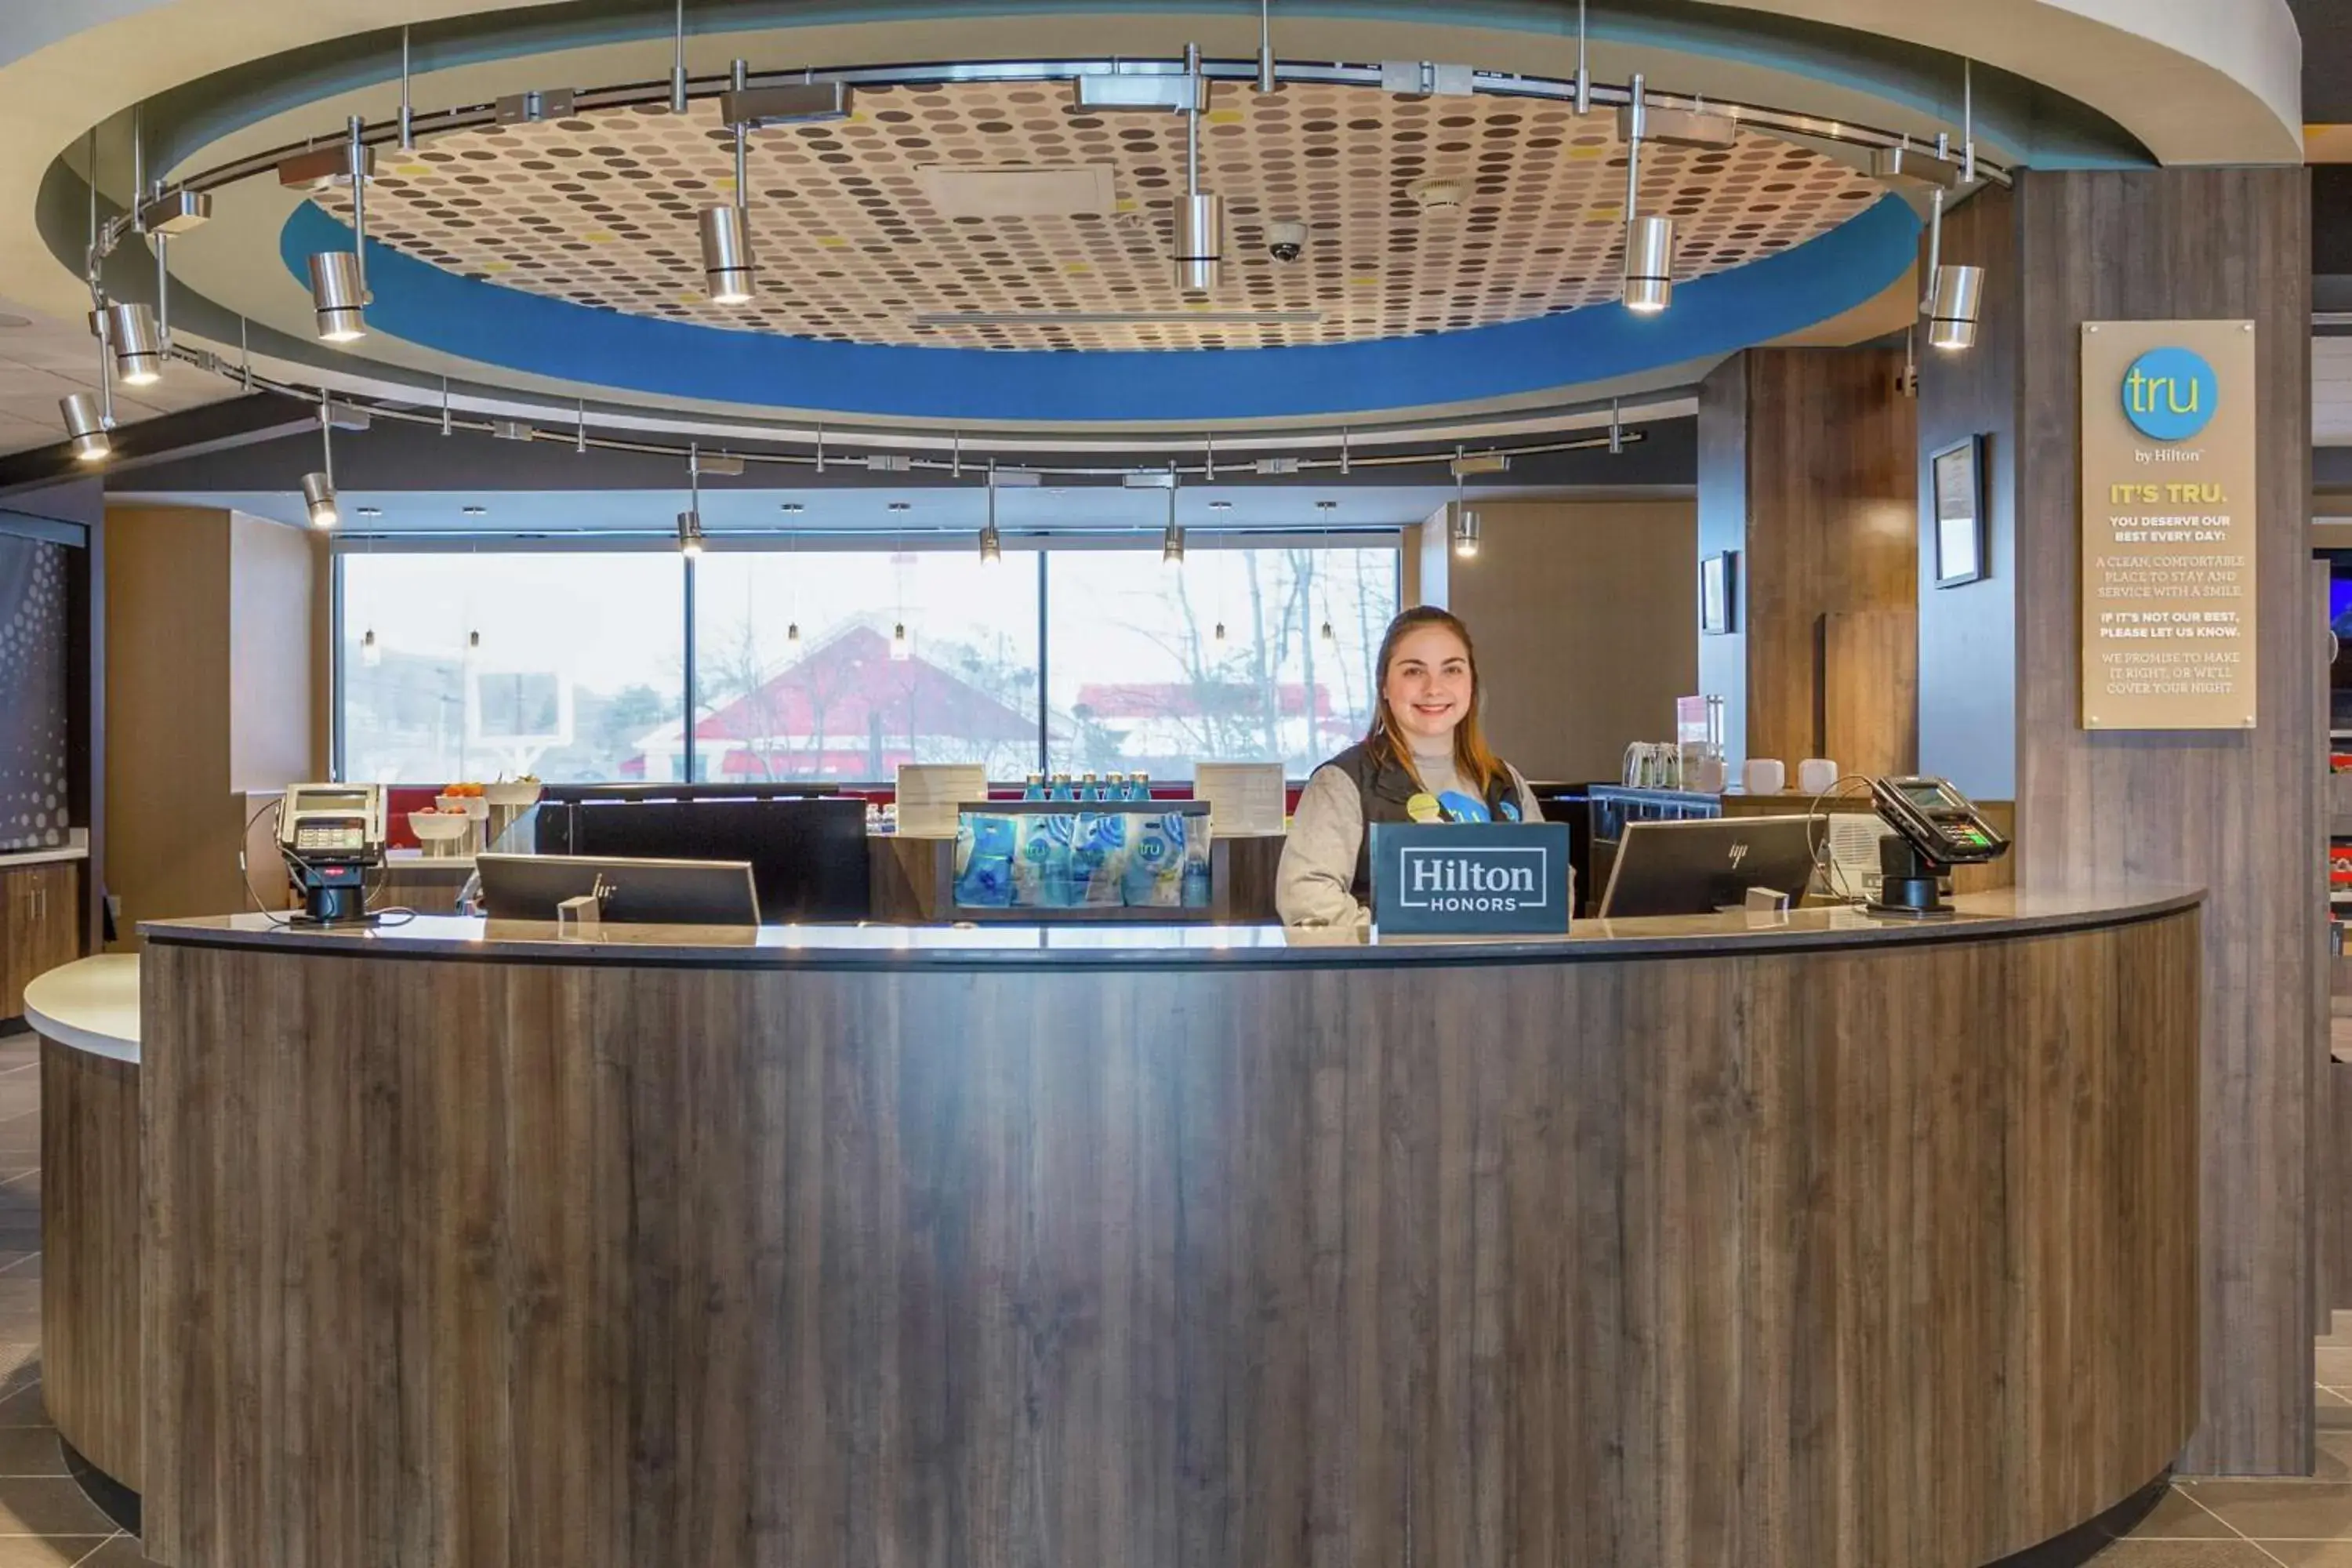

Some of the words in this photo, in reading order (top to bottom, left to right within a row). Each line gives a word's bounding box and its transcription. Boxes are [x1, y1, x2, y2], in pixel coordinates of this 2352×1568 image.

[2127, 368, 2198, 414] tru
[2135, 449, 2152, 464] by
[2111, 484, 2159, 504] IT'S
[2165, 483, 2228, 504] TRU.
[2110, 516, 2138, 528] YOU
[2141, 516, 2199, 527] DESERVE
[2201, 515, 2230, 527] OUR
[2115, 531, 2147, 543] BEST
[2151, 531, 2192, 543] EVERY
[2194, 530, 2227, 542] DAY:
[2096, 557, 2105, 568] A
[2107, 557, 2151, 568] CLEAN,
[2154, 555, 2245, 568] COMFORTABLE
[2104, 572, 2147, 583] PLACE
[2149, 572, 2169, 583] TO
[2171, 571, 2205, 583] STAY
[2207, 571, 2238, 584] AND
[2097, 587, 2151, 598] SERVICE
[2153, 586, 2189, 598] WITH
[2190, 586, 2201, 598] A
[2100, 612, 2114, 624] IF
[2116, 612, 2140, 623] IT'S
[2143, 612, 2169, 622] NOT
[2172, 612, 2201, 622] OUR
[2204, 612, 2240, 623] BEST,
[2100, 628, 2148, 638] PLEASE
[2151, 627, 2172, 638] LET
[2176, 627, 2194, 637] US
[2197, 626, 2241, 638] KNOW.
[2102, 653, 2122, 664] WE
[2125, 652, 2181, 664] PROMISE
[2183, 652, 2201, 664] TO
[2204, 652, 2240, 663] MAKE
[2110, 668, 2123, 679] IT
[2172, 667, 2192, 678] OR
[2107, 683, 2150, 695] COVER
[2152, 683, 2190, 694] YOUR
[1025, 844, 1047, 856] tru
[1140, 843, 1160, 856] tru
[1413, 859, 1534, 891] Hilton
[1431, 898, 1517, 912] HONORS
